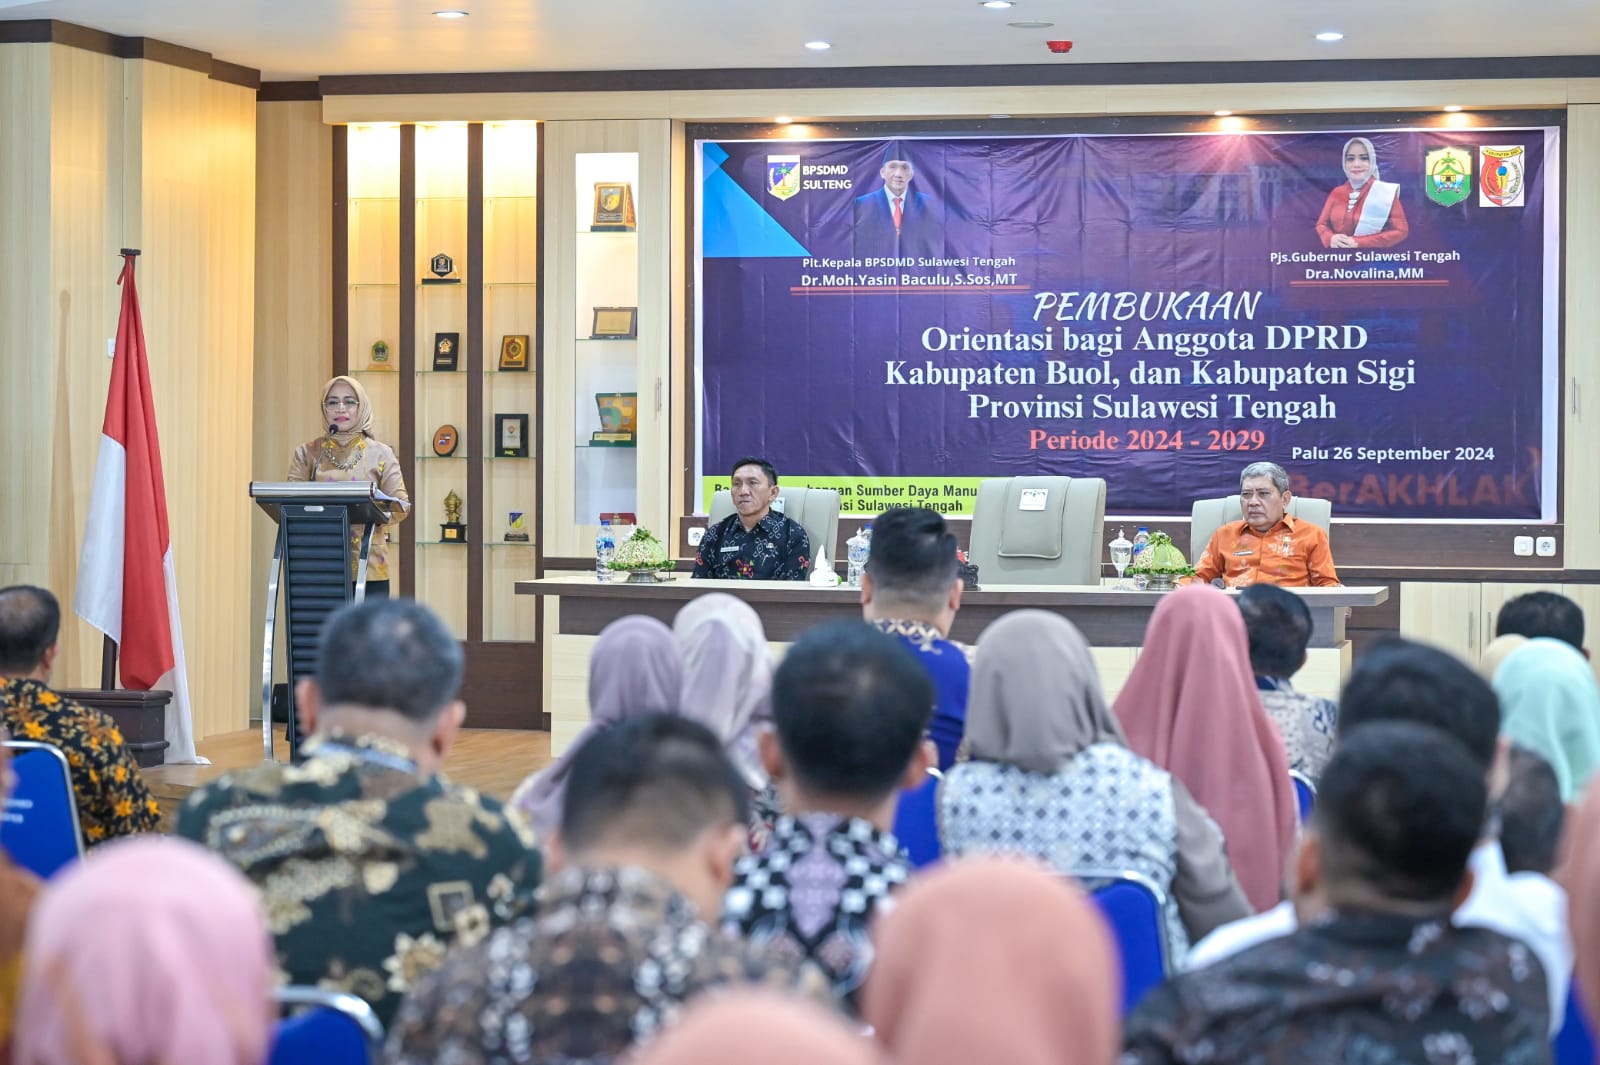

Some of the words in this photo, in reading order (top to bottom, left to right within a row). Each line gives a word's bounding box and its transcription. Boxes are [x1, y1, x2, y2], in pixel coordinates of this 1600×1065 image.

[802, 164, 848, 175] BPSDMD
[802, 179, 852, 189] SULTENG
[802, 257, 862, 269] Plt.Kepala
[865, 257, 915, 267] BPSDMD
[918, 256, 969, 267] Sulawesi
[973, 256, 1016, 269] Tengah
[1270, 252, 1352, 265] Pjs.Gubernur
[1355, 251, 1411, 262] Sulawesi
[1414, 250, 1461, 263] Tengah
[801, 274, 897, 286] Dr.Moh.Yasin
[901, 273, 1018, 287] Baculu,S.Sos,MT
[1305, 268, 1424, 280] Dra.Novalina,MM
[1033, 290, 1262, 321] PEMBUKAAN
[921, 326, 1053, 351] Orientasi
[1063, 326, 1122, 357] bagi
[1133, 326, 1255, 357] Anggota
[1264, 325, 1368, 350] DPRD
[884, 360, 1036, 391] Kabupaten
[1045, 360, 1120, 389] Buol,
[1129, 360, 1181, 385] dan
[1190, 360, 1348, 391] Kabupaten
[1357, 359, 1416, 391] Sigi
[968, 394, 1083, 419] Provinsi
[1093, 394, 1218, 419] Sulawesi
[1227, 394, 1337, 425] Tengah
[1029, 429, 1119, 450] Periode
[1127, 429, 1184, 450] 2024
[1207, 429, 1265, 450] 2029
[1292, 447, 1329, 460] Palu
[1333, 447, 1353, 460] 26
[1357, 447, 1451, 463] September
[1455, 447, 1495, 460] 2024
[856, 484, 905, 497] Sumber
[908, 485, 939, 499] Daya
[943, 485, 978, 497] Manu
[917, 500, 963, 513] Tengah
